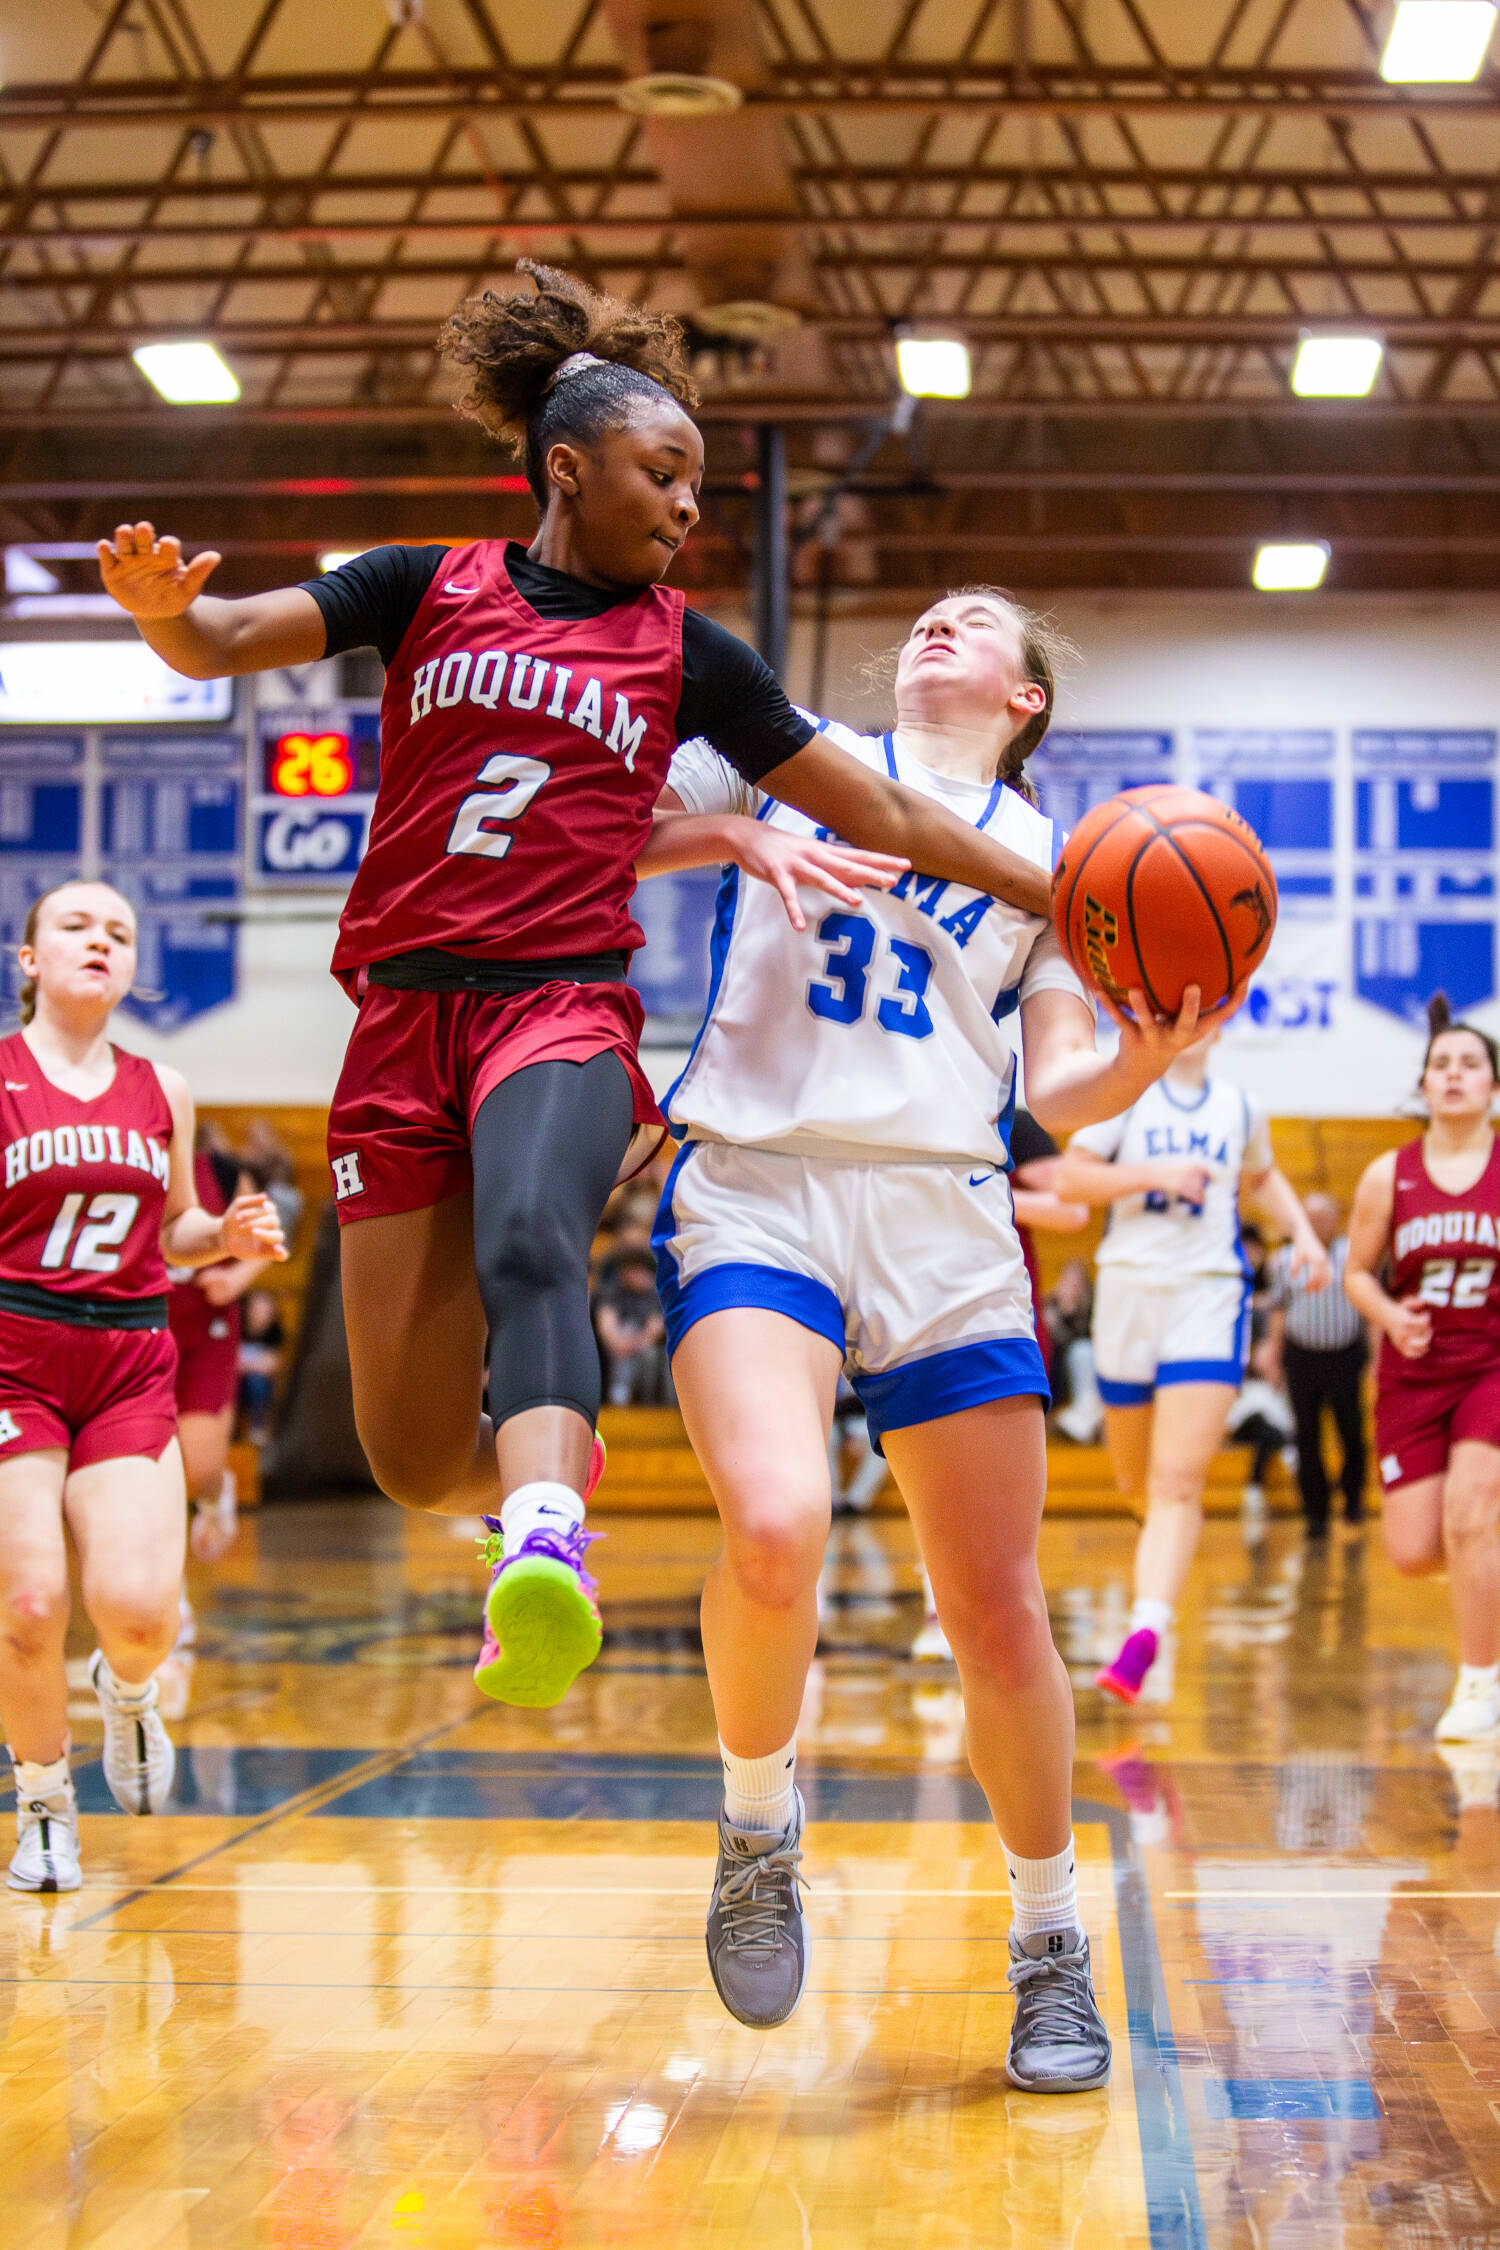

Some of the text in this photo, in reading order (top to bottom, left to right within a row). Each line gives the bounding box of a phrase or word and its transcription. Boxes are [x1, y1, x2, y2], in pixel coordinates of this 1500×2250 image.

[410, 650, 648, 774] HOQUIAM
[273, 732, 353, 797] 26
[265, 806, 350, 870] Go
[446, 752, 552, 860] 2
[807, 908, 937, 1043] 33
[4, 1125, 170, 1191] HOQUIAM
[331, 1151, 365, 1201] H
[1144, 1126, 1228, 1165] ELMA
[41, 1193, 139, 1272] 12
[1395, 1210, 1500, 1261] HOQUIA
[1419, 1258, 1496, 1308] 22
